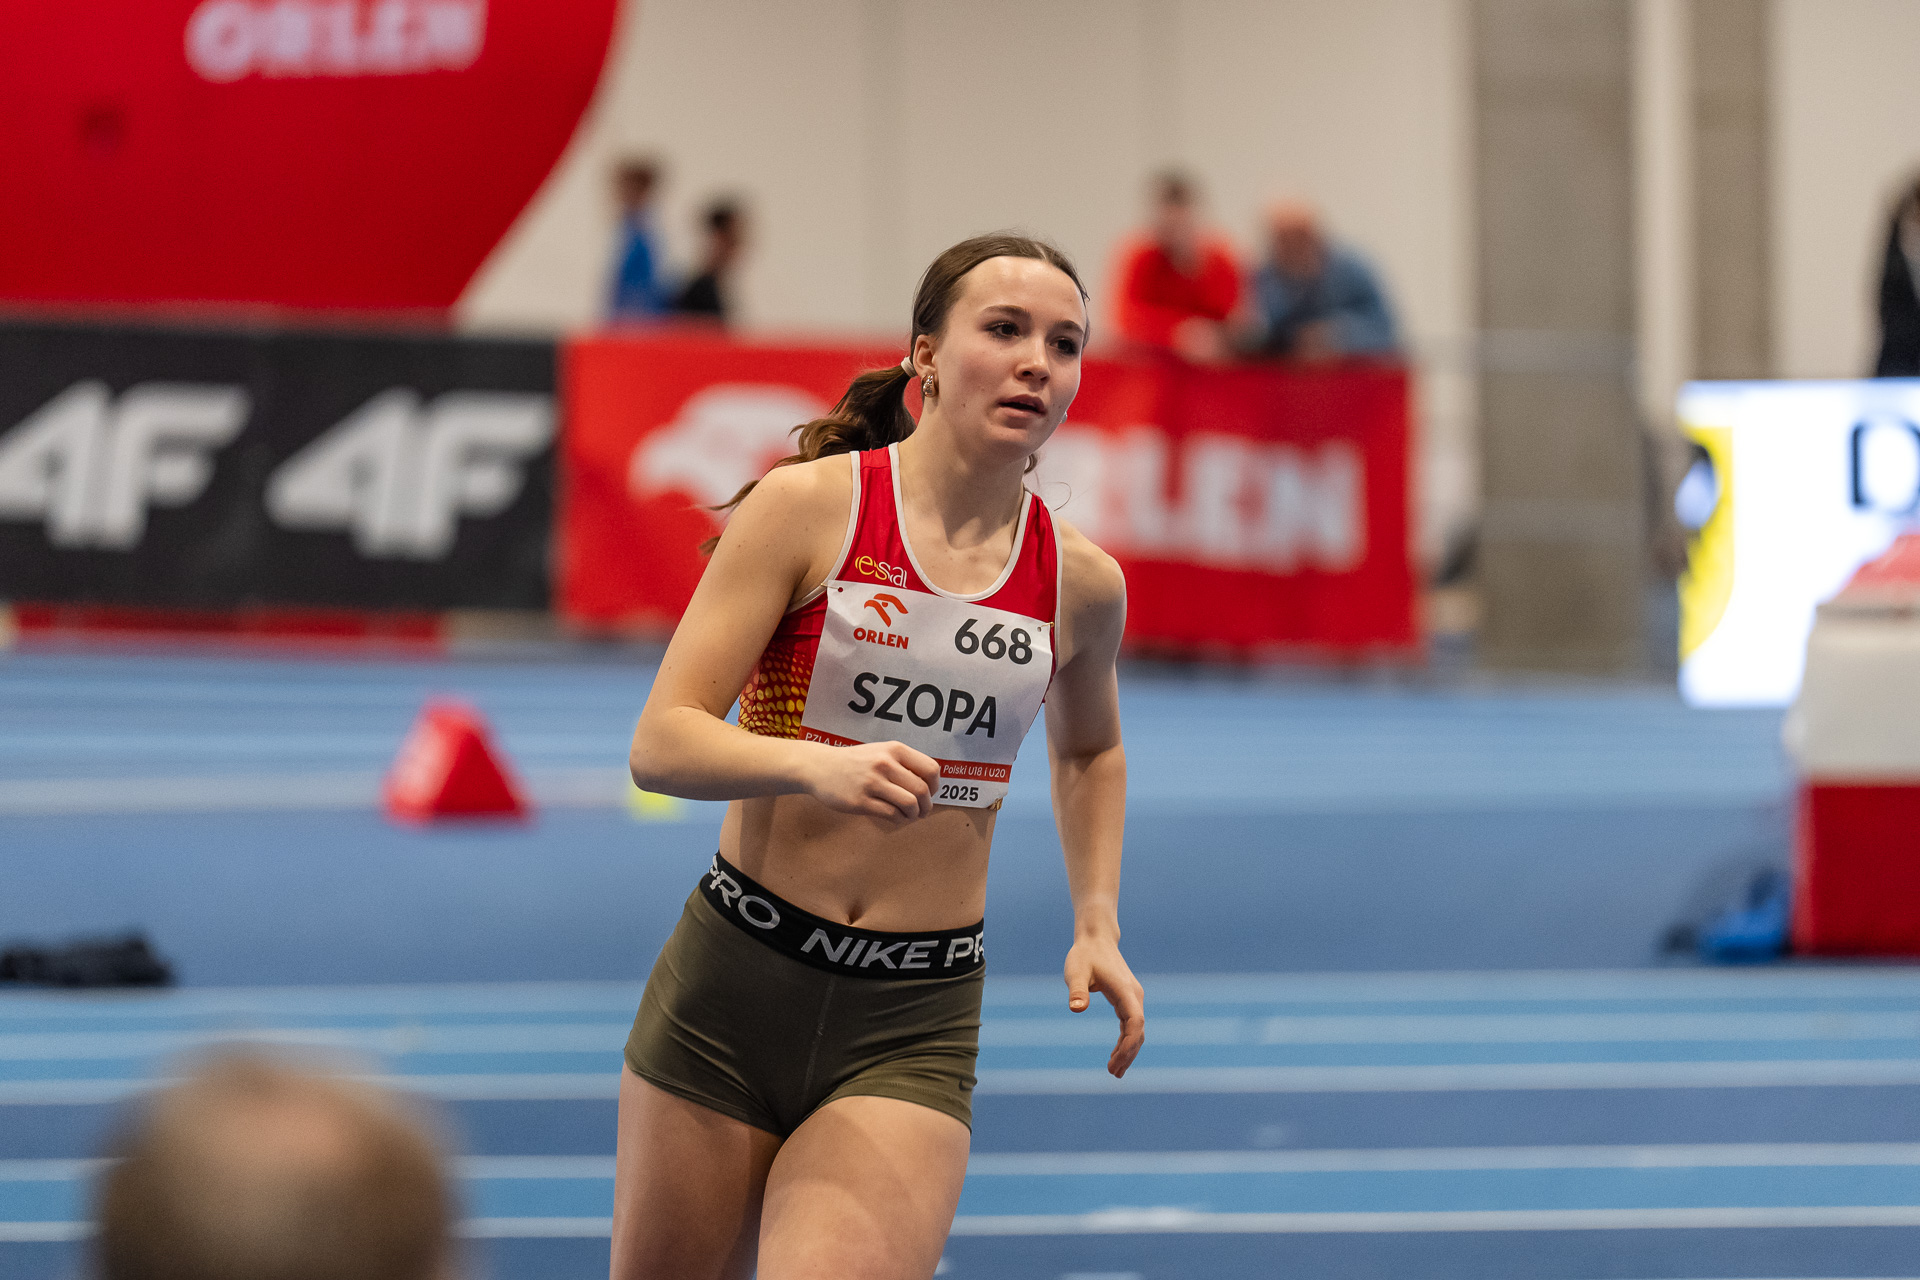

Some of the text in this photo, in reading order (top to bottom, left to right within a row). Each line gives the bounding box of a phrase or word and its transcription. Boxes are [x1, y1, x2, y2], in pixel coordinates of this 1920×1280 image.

[0, 380, 250, 550] 4F
[267, 388, 556, 559] 4F
[853, 627, 909, 650] ORLEN
[954, 618, 1033, 665] 668
[847, 671, 997, 739] SZOPA
[939, 784, 979, 802] 2025
[943, 764, 967, 776] Polski
[968, 766, 983, 777] U18
[989, 768, 1006, 778] U20
[800, 928, 939, 970] NIKE
